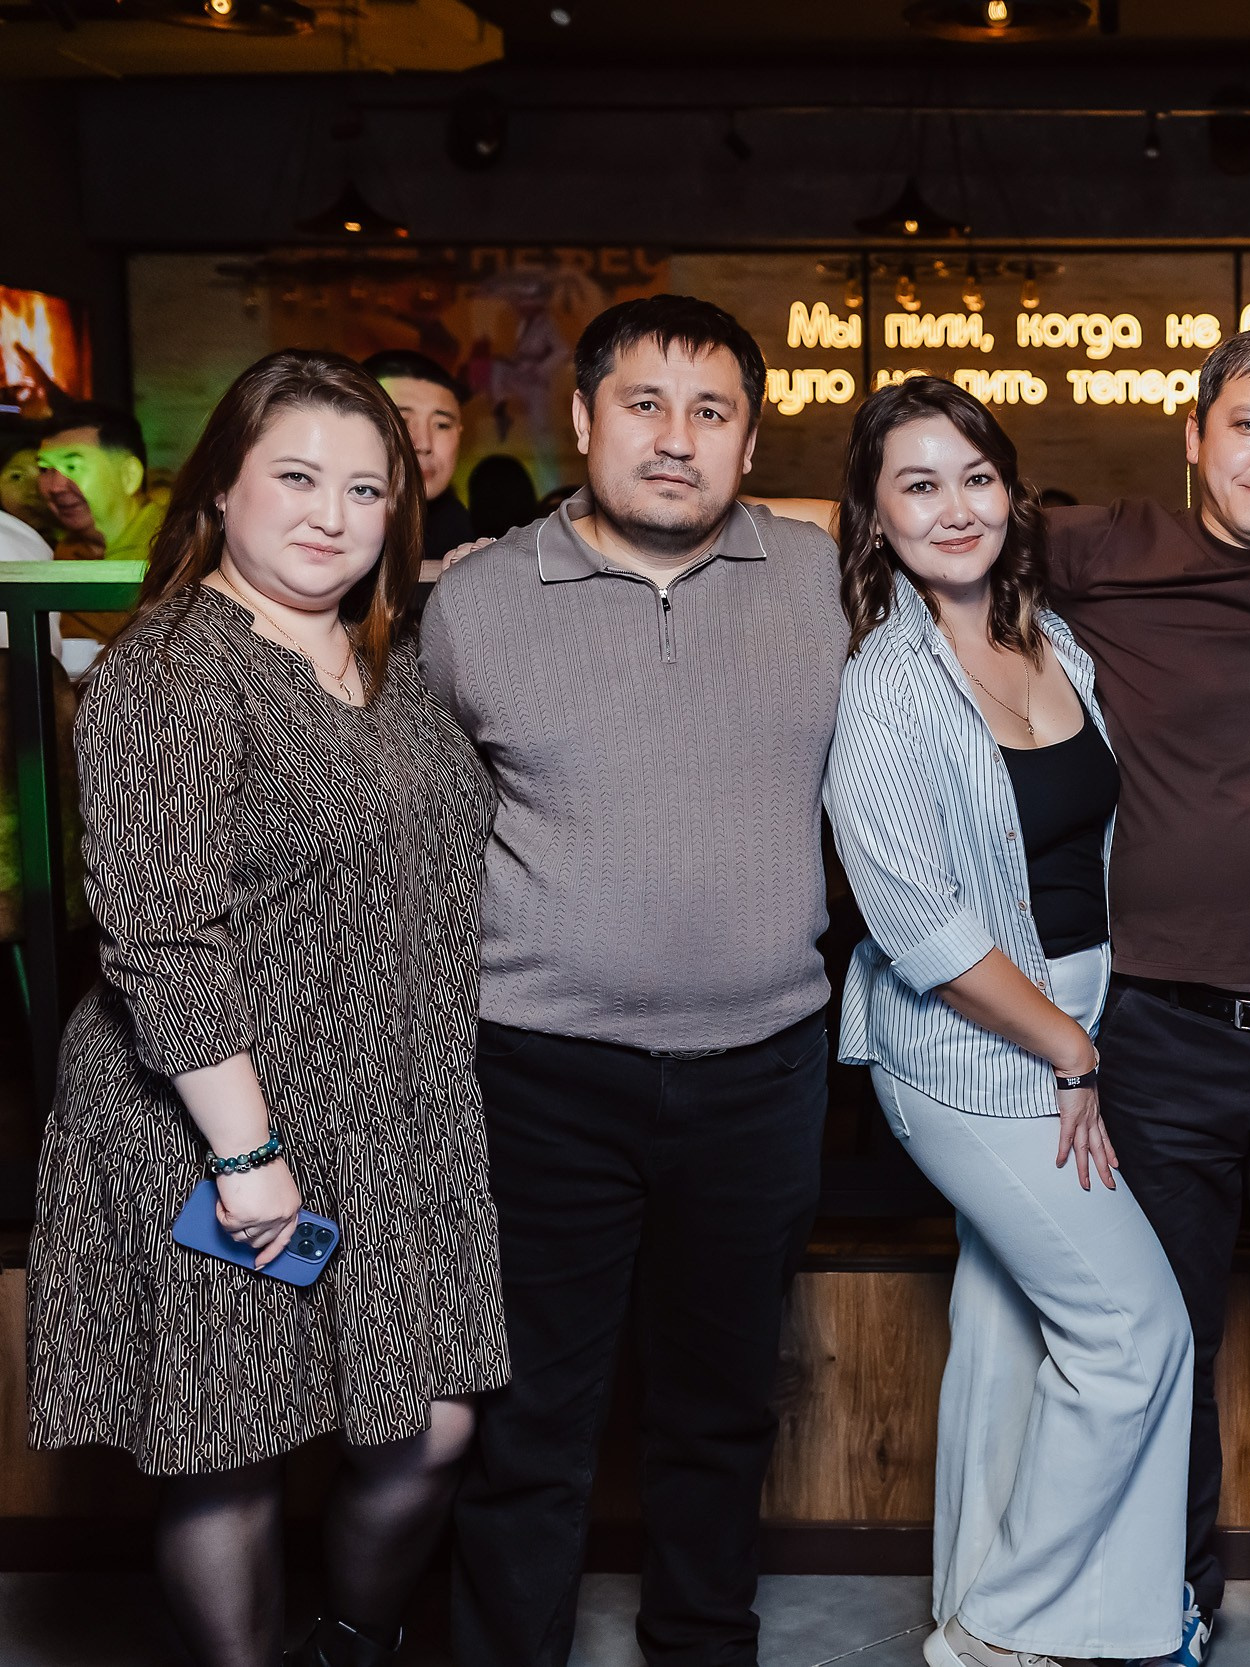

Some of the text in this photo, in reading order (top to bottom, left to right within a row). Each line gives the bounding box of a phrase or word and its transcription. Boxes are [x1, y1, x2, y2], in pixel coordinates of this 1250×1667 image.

[787, 301, 862, 348] Мы
[885, 313, 994, 352] пили,
[1017, 313, 1142, 361] когда
[1166, 313, 1221, 349] не
[766, 369, 855, 416] лупо
[954, 369, 1048, 405] пить
